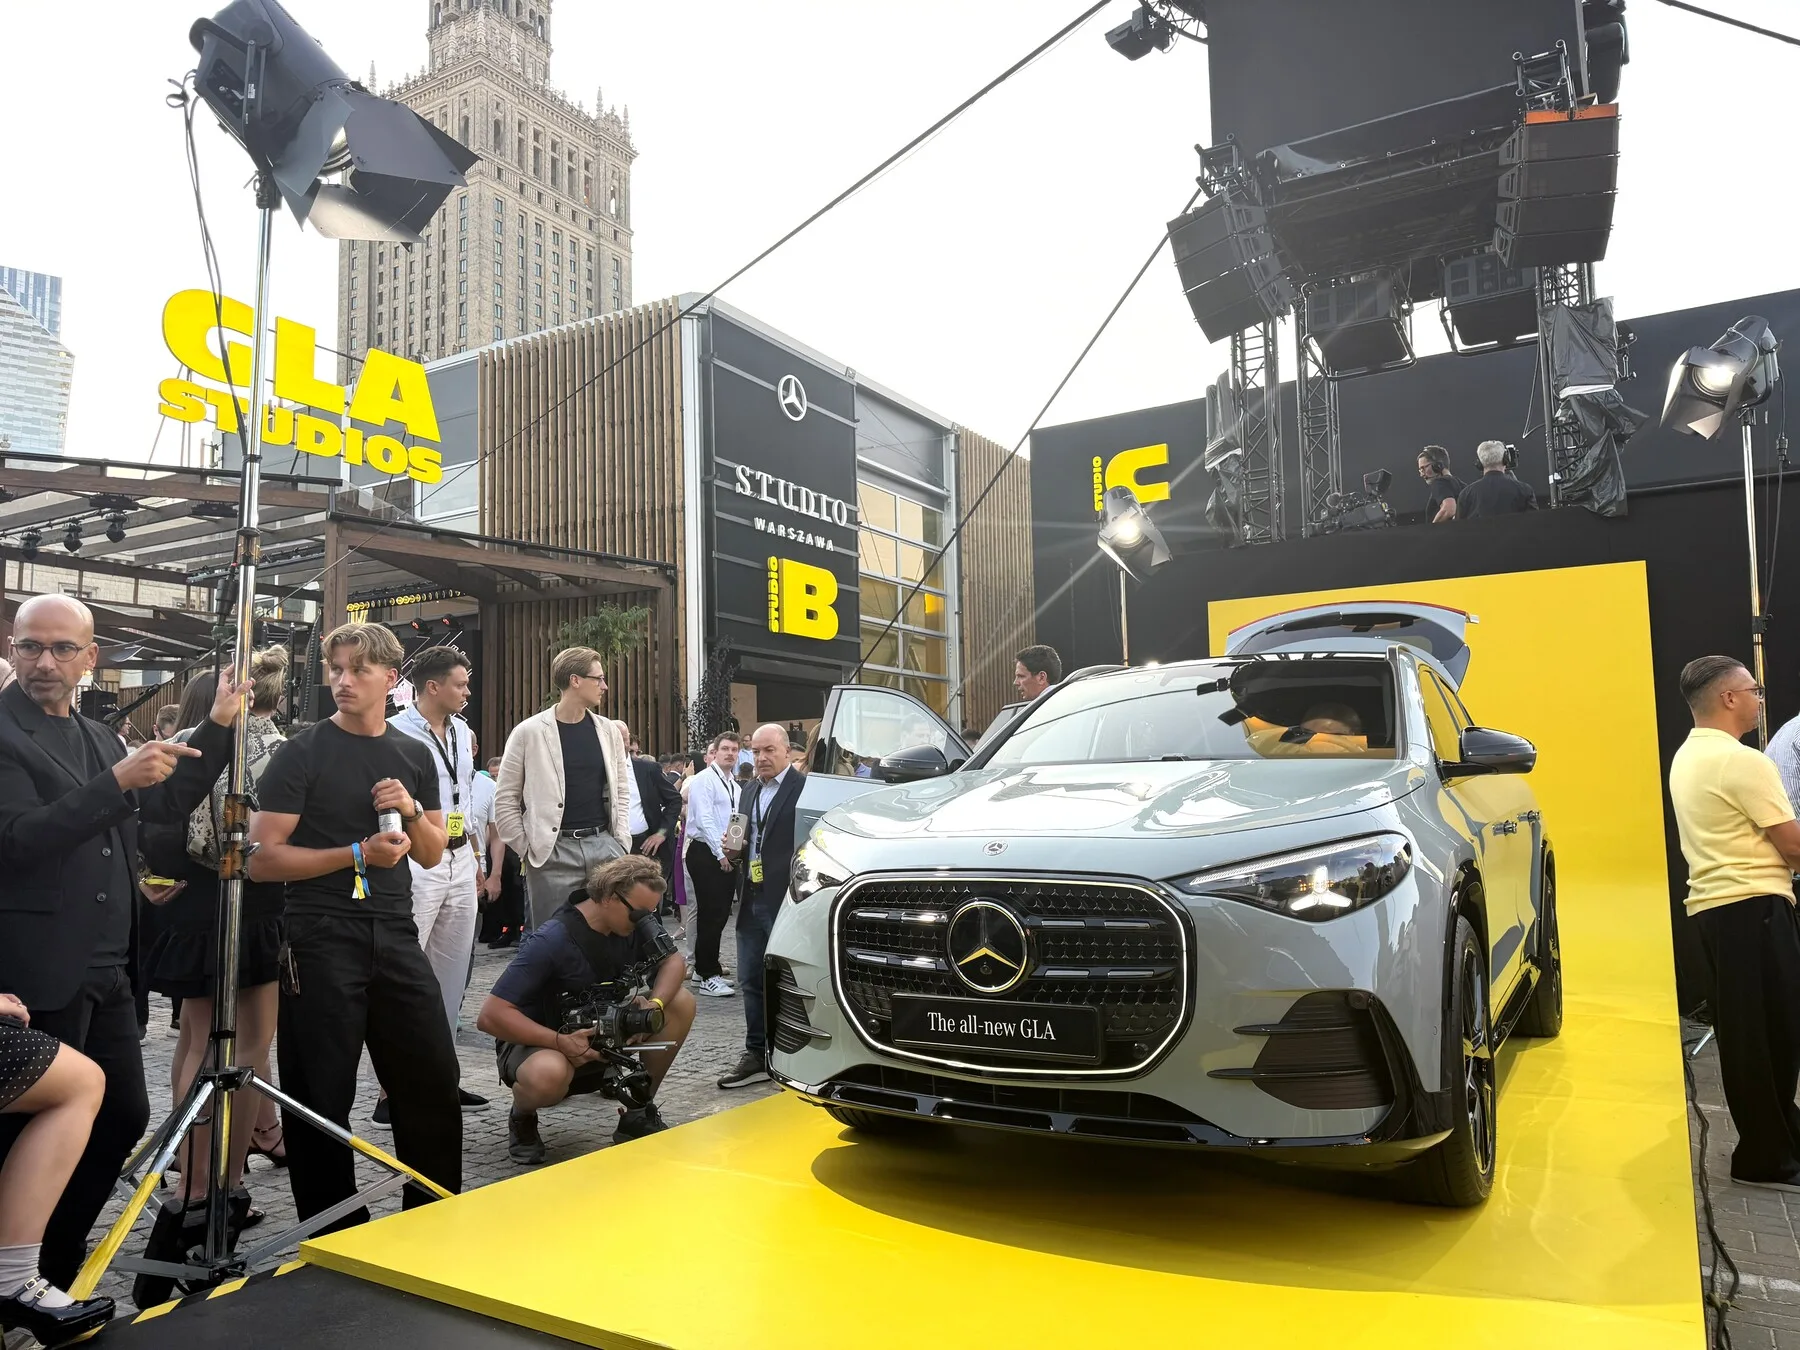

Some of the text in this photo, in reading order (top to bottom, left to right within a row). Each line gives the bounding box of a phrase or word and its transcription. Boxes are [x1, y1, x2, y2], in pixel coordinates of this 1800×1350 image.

[162, 288, 442, 443] GLA
[158, 377, 443, 484] STUDIOS
[735, 464, 848, 527] STUDIO
[1092, 455, 1104, 512] STUDIO
[1105, 442, 1171, 504] C
[753, 516, 834, 552] WARSZAWA
[767, 555, 780, 633] STUDIO
[779, 557, 839, 641] B
[927, 1011, 1057, 1041] The all-new GLA
